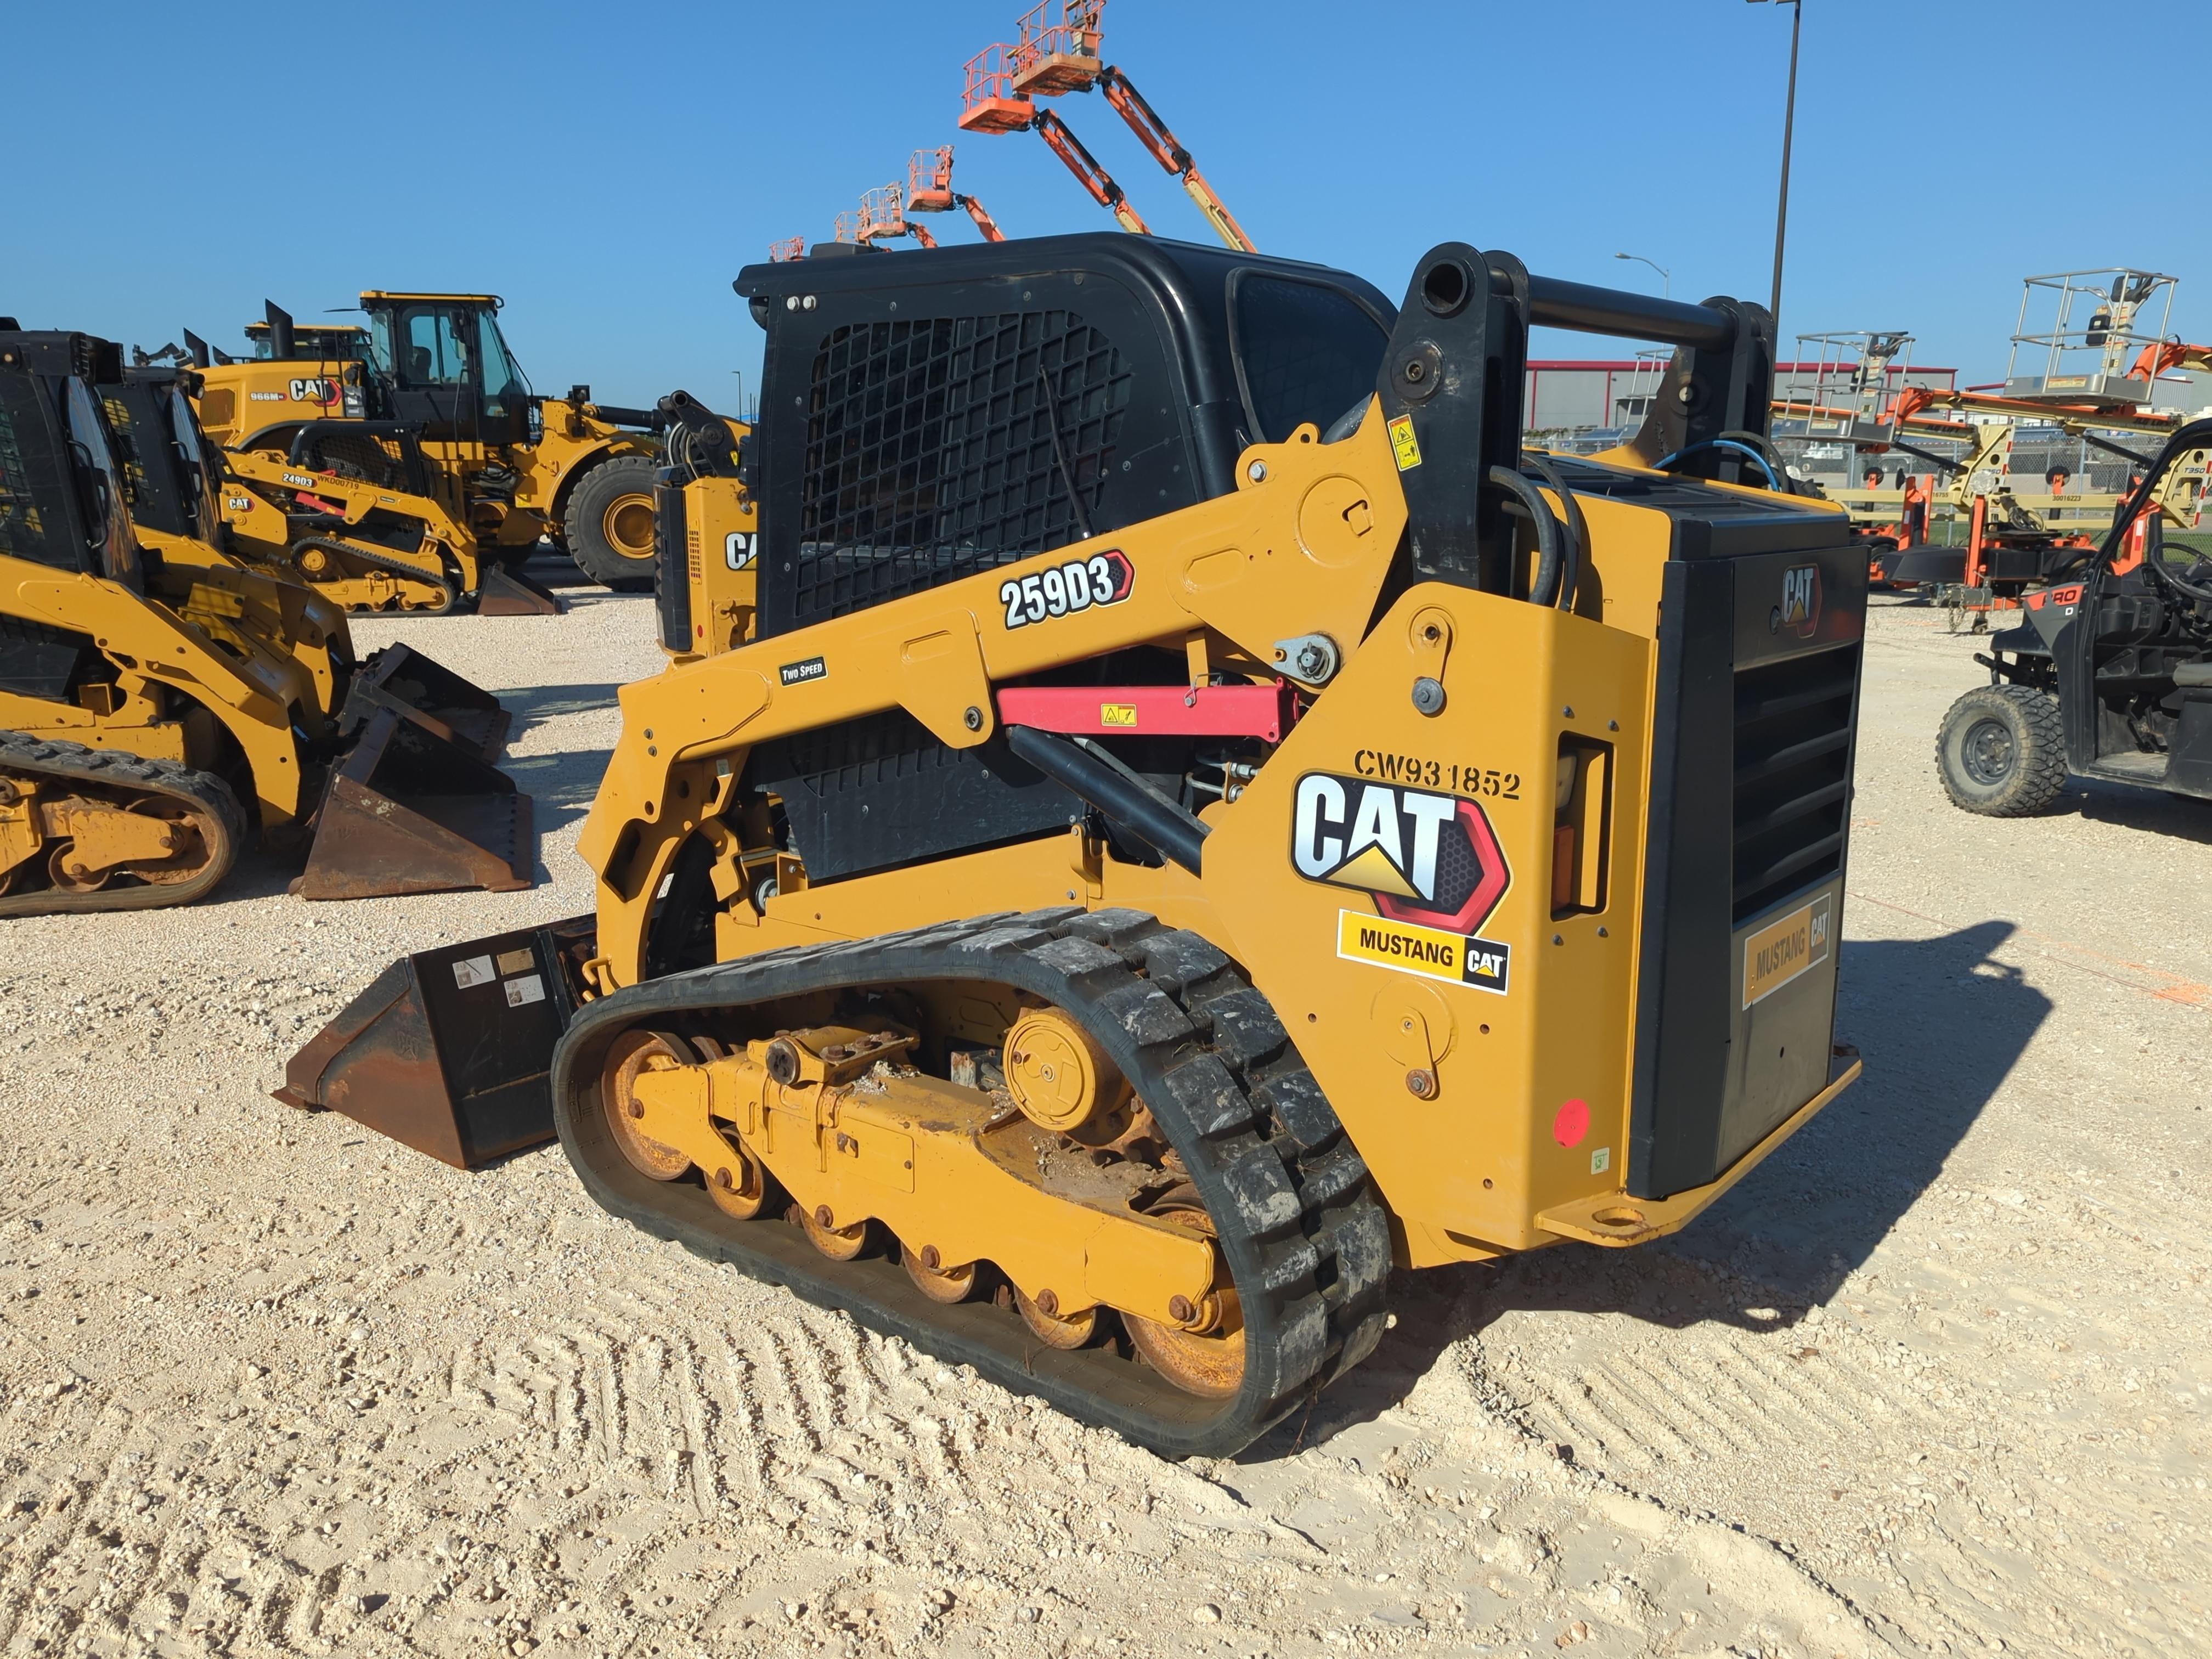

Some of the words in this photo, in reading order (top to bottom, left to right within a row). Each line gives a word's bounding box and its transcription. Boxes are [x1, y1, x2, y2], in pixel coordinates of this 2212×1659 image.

[290, 379, 328, 402] CAT
[229, 498, 249, 510] CAT
[283, 473, 312, 487] 249D3
[318, 475, 359, 489] WKD00719
[1001, 556, 1113, 627] 259D3
[1784, 568, 1814, 623] CAT
[2065, 607, 2074, 616] D
[1354, 749, 1521, 800] CW931852
[1295, 775, 1455, 901] CAT
[1360, 928, 1453, 967] MUSTANG
[1467, 950, 1503, 978] CAT
[1757, 927, 1805, 981] MUSTANG
[1811, 912, 1828, 948] CAT
